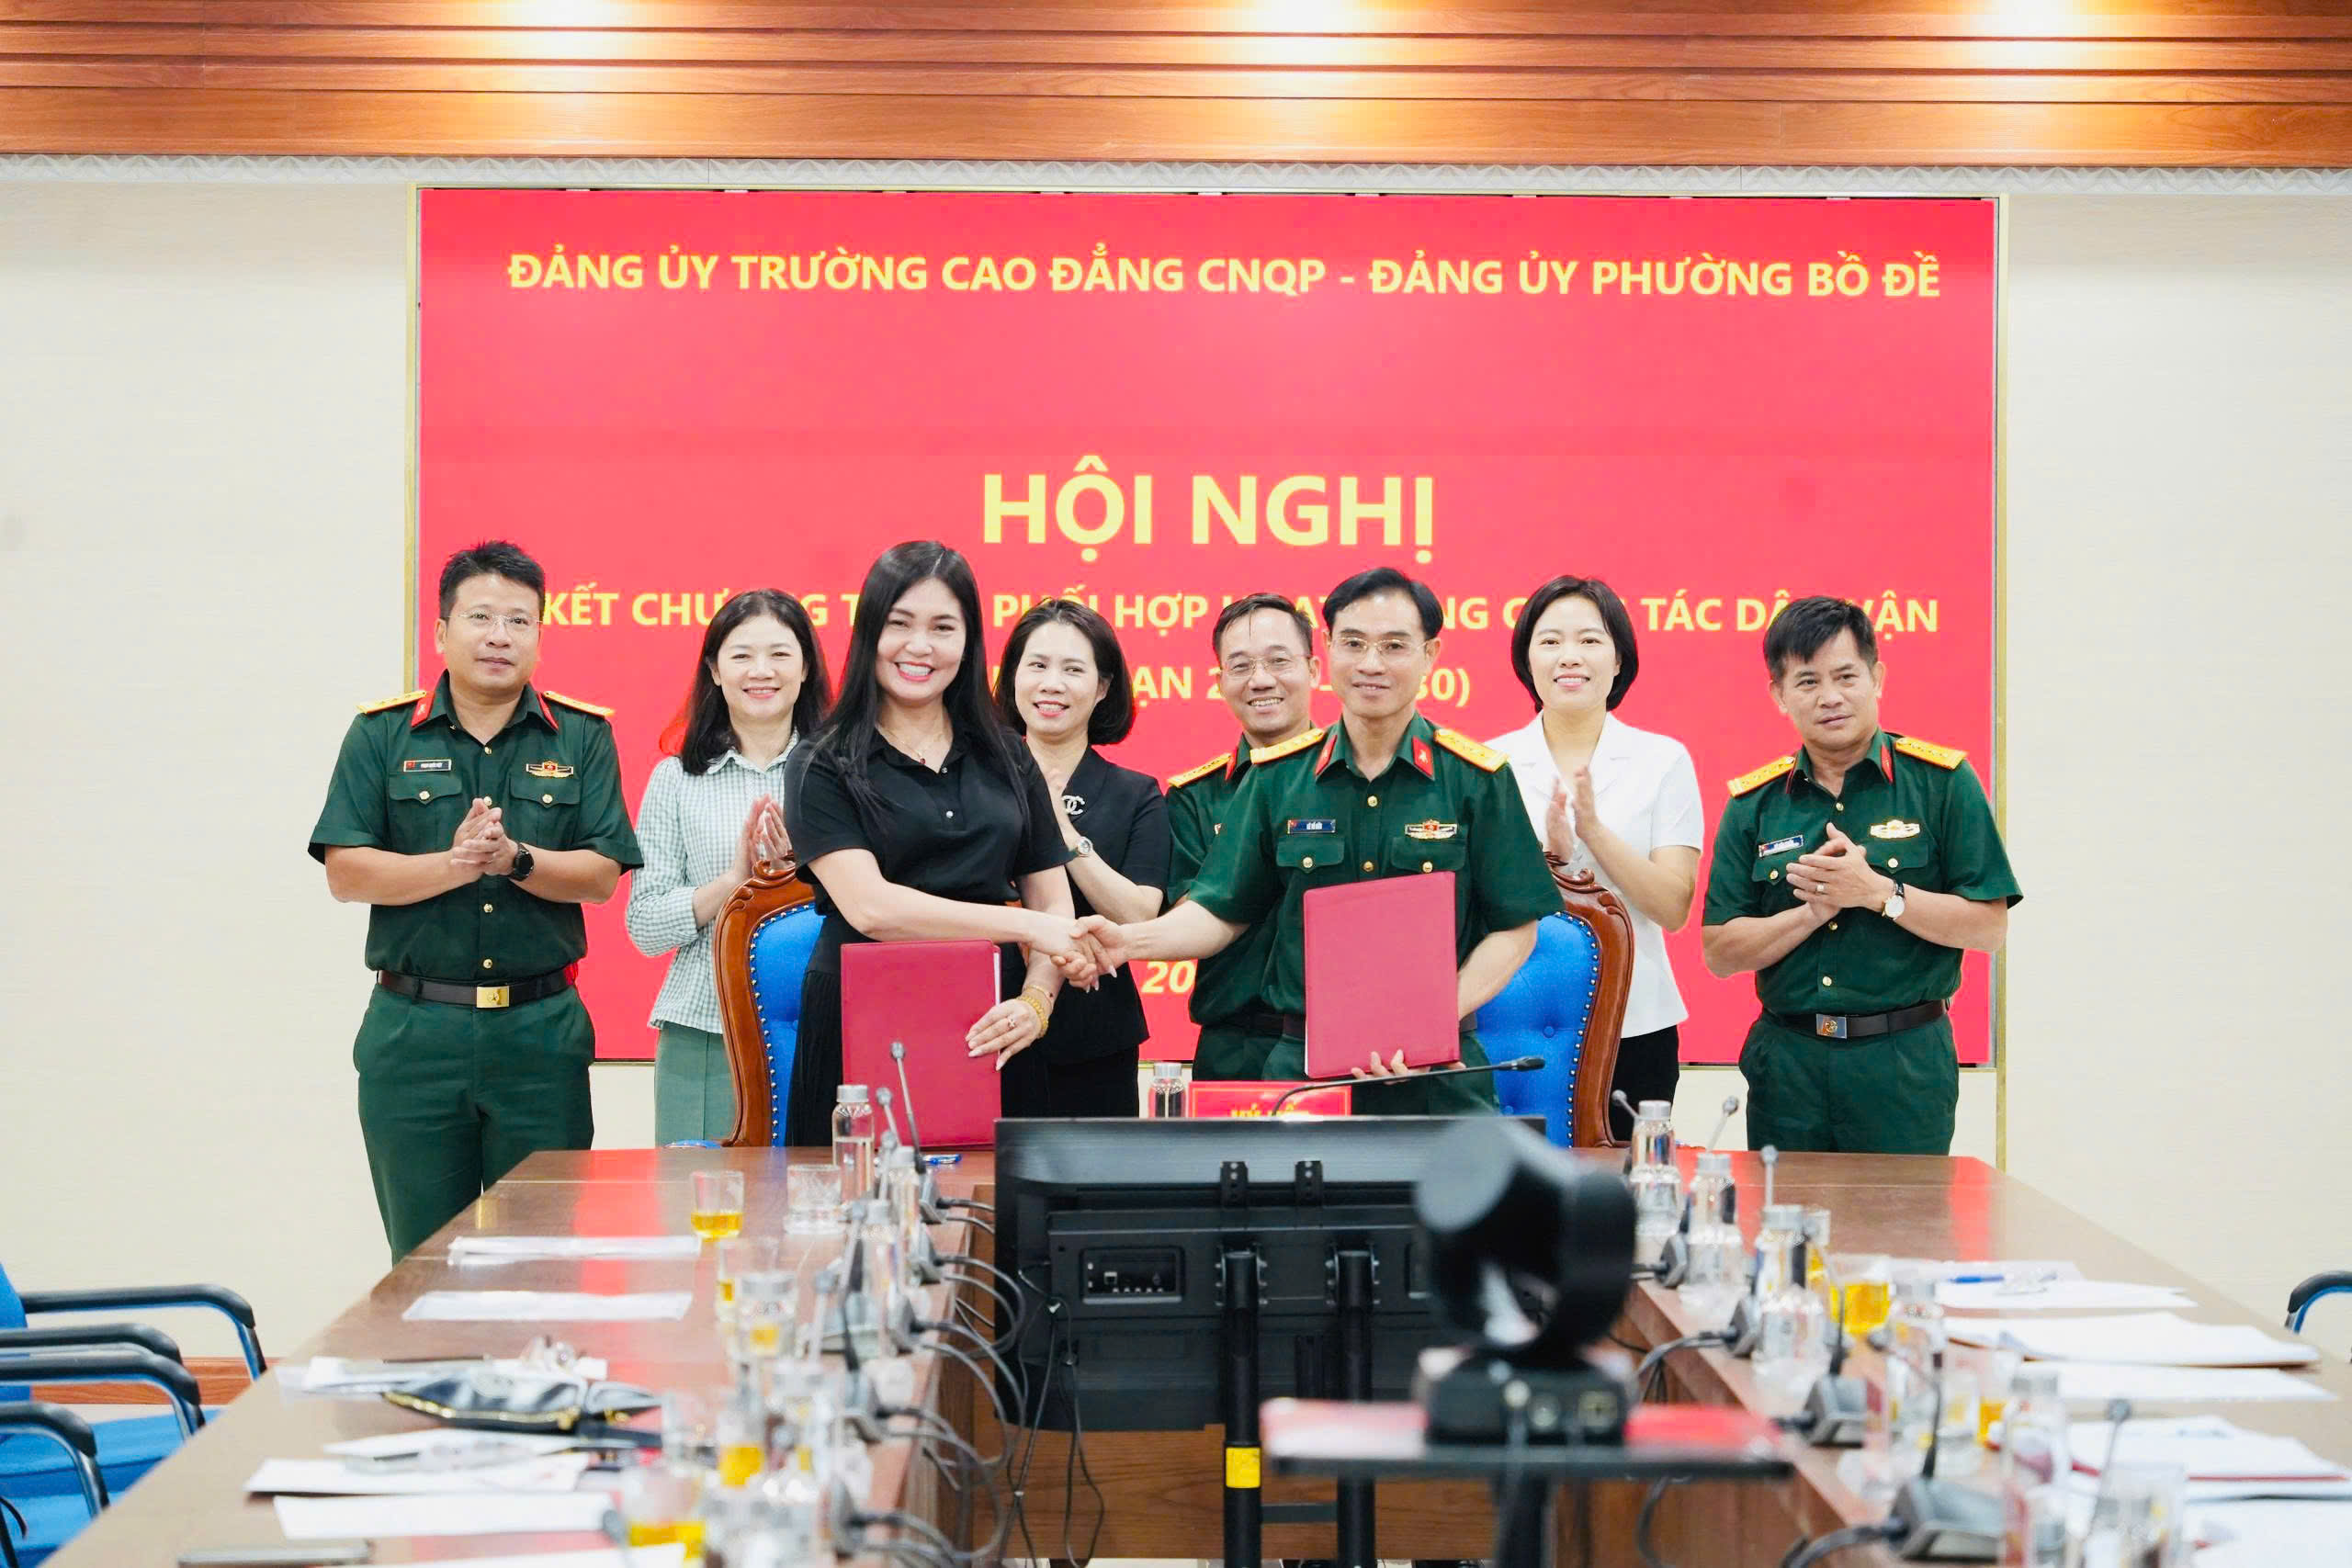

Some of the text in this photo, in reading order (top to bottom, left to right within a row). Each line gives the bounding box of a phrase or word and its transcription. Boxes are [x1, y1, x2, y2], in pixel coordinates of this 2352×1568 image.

[507, 243, 643, 289] ĐẢNG
[658, 244, 718, 289] ỦY
[731, 246, 927, 290] TRƯỜNG
[942, 256, 1037, 291] CAO
[1048, 242, 1184, 292] ĐẲNG
[1197, 258, 1327, 297] CNQP
[1368, 249, 1503, 295] ĐẢNG
[1519, 250, 1578, 295] ỦY
[1592, 252, 1792, 297] PHƯỜNG
[1807, 250, 1870, 297] BỒ
[1881, 251, 1941, 298] ĐỀ
[983, 455, 1433, 564] HỘI NGHỊ
[543, 581, 619, 626] KẾT
[1114, 592, 1209, 637] HỢP
[1640, 588, 1723, 631] TÁC
